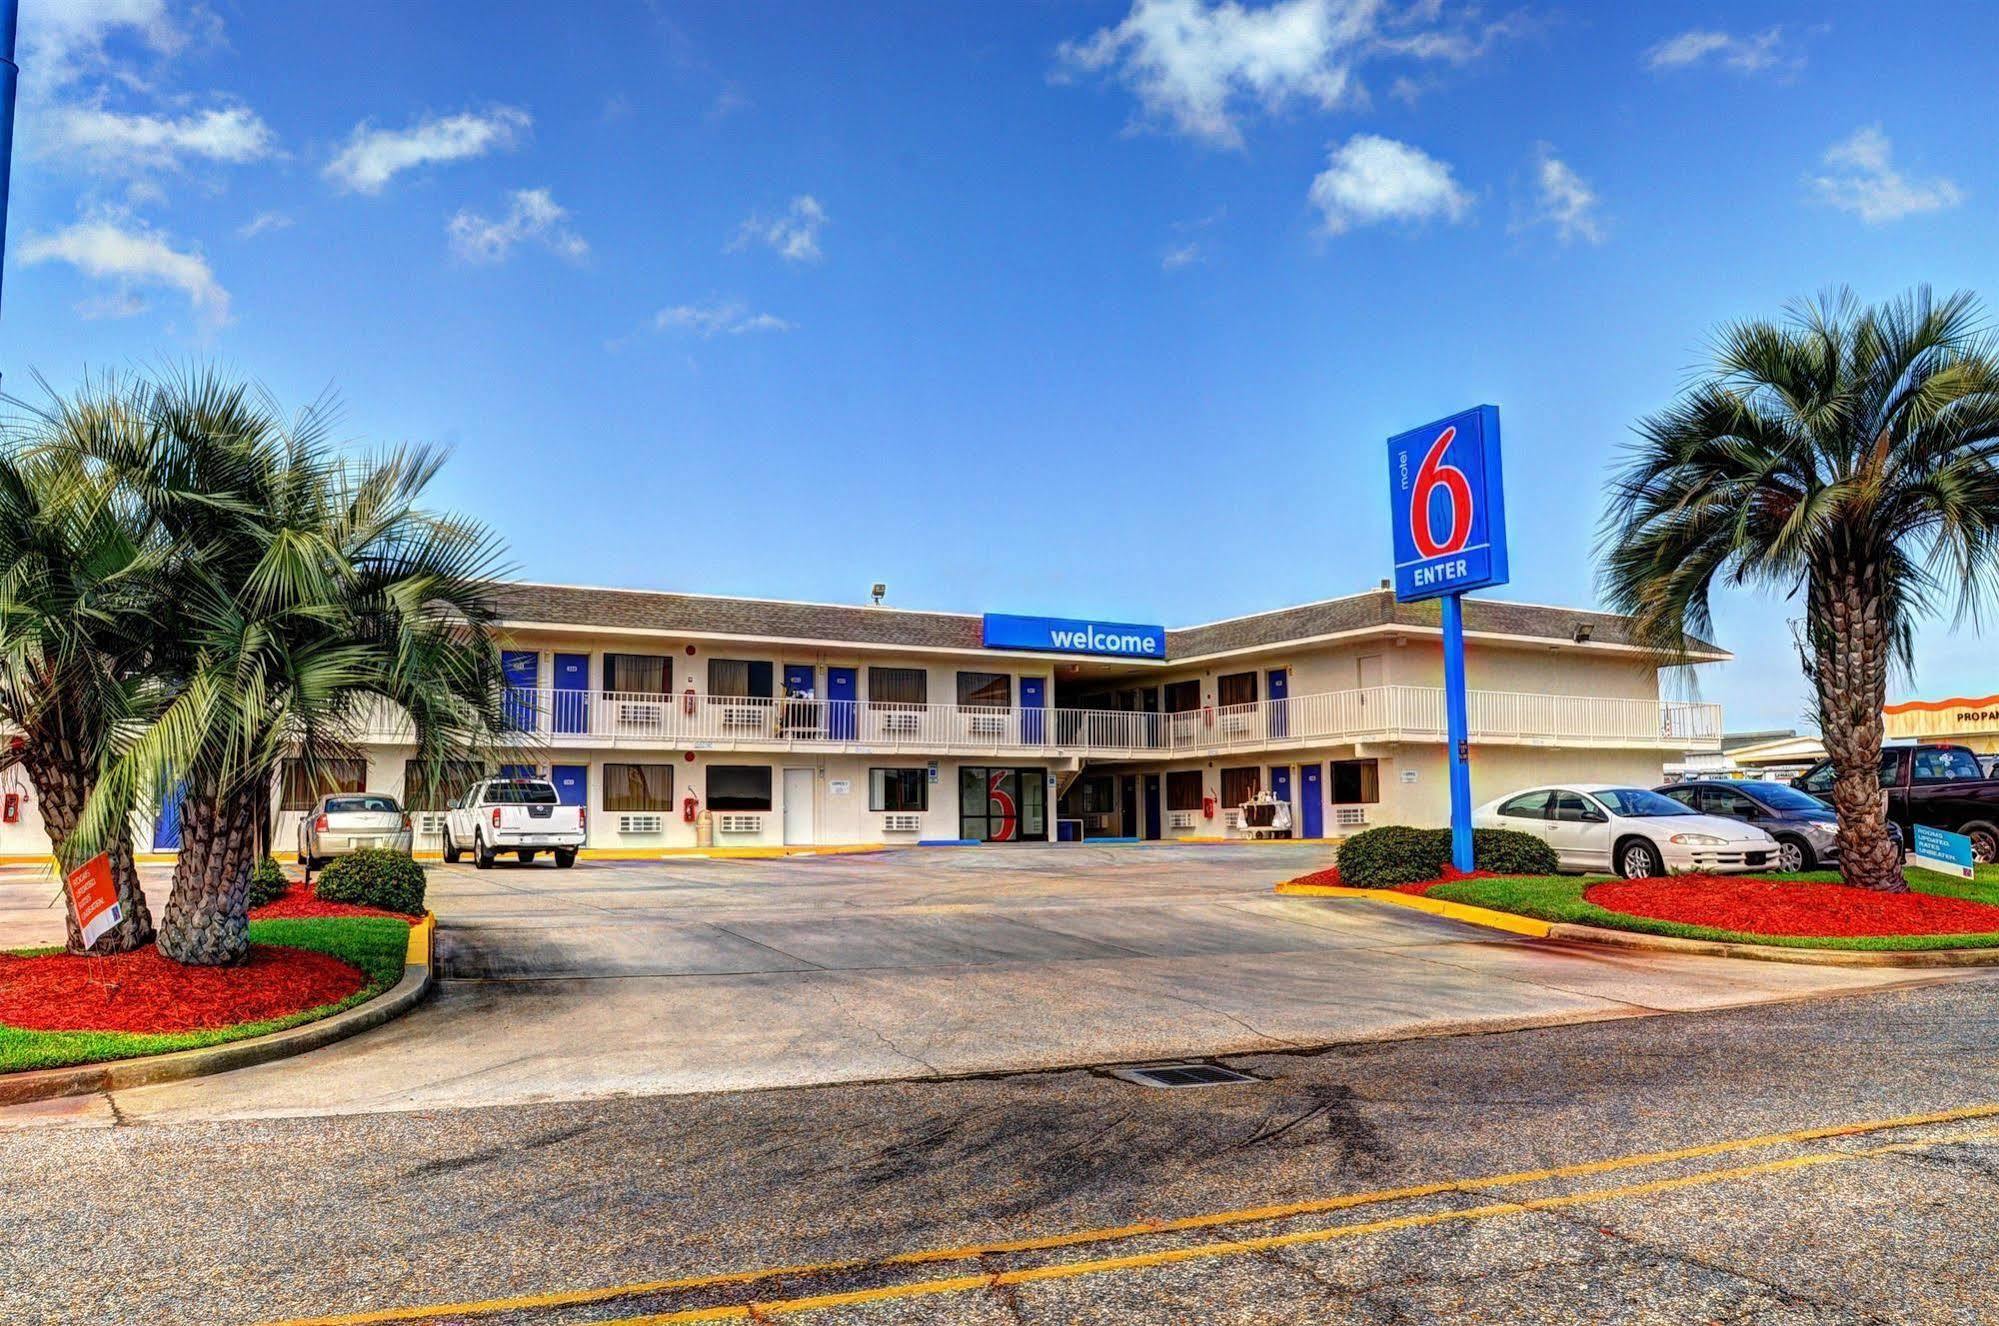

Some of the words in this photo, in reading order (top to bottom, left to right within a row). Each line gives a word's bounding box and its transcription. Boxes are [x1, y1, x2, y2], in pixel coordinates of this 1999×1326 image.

[1399, 451, 1408, 490] motel
[1410, 426, 1473, 559] 6
[1414, 559, 1467, 587] ENTER
[1051, 625, 1156, 653] welcome
